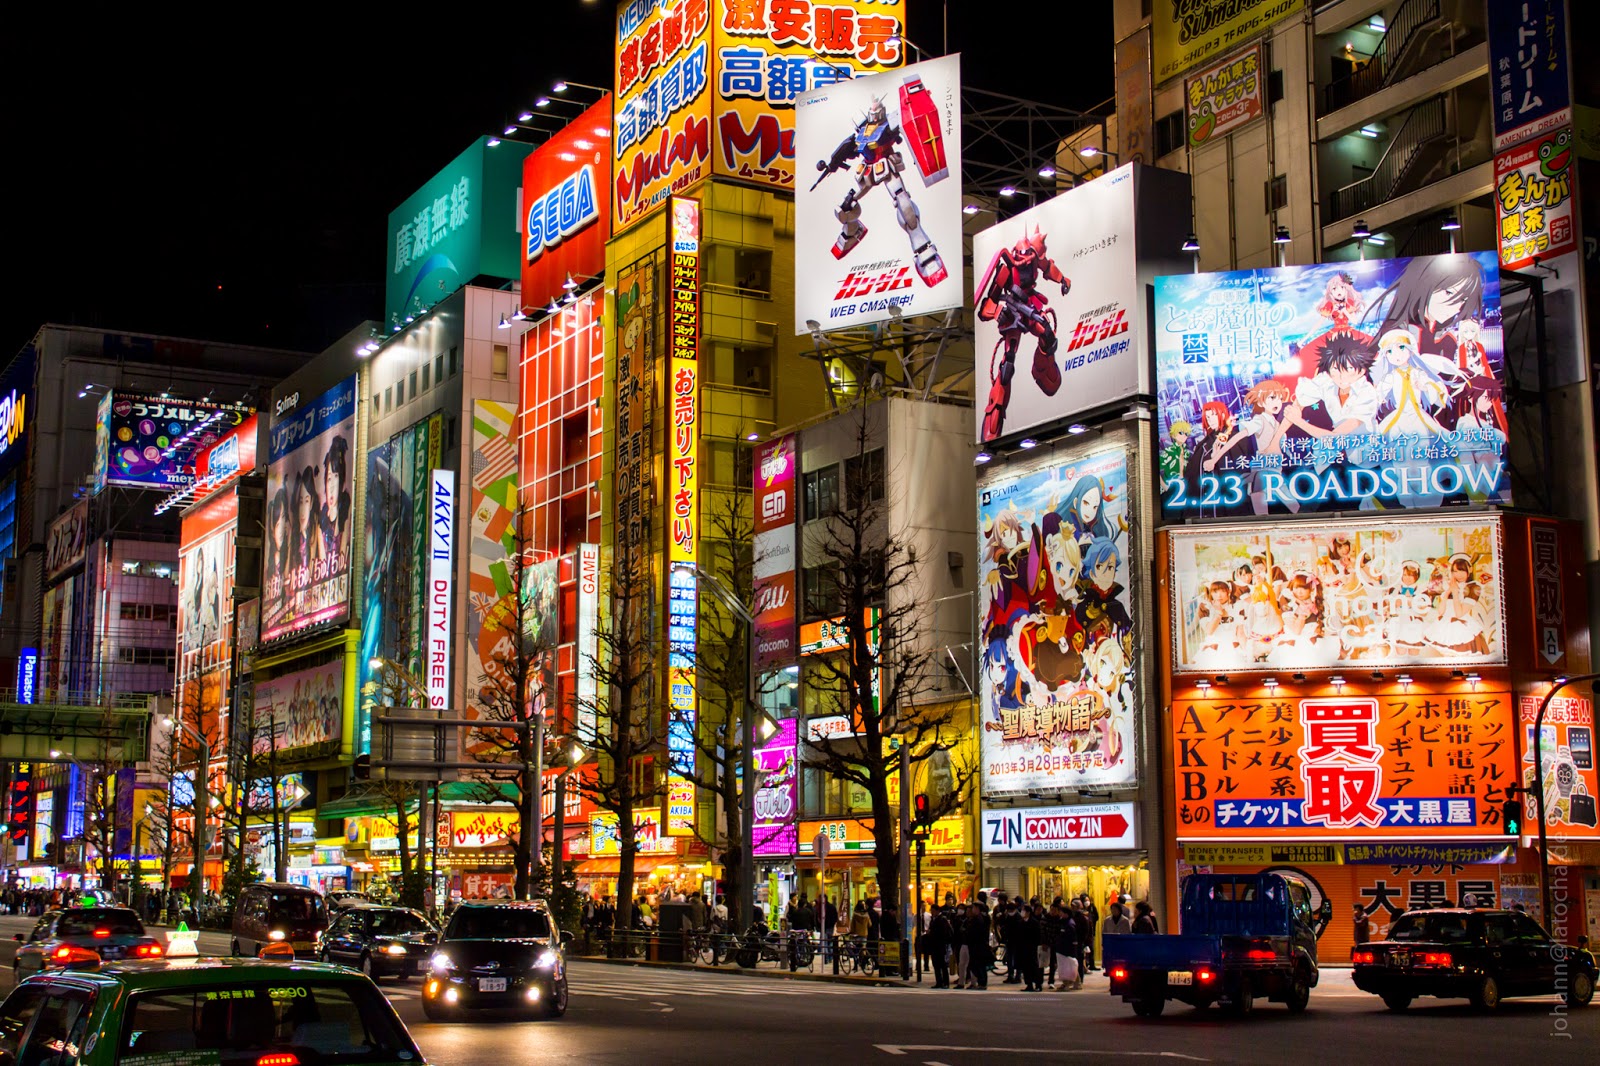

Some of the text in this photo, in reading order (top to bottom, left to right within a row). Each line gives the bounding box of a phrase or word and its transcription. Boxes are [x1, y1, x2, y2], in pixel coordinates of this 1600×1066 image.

[722, 0, 901, 64] 激安販売
[720, 46, 880, 104] 高額買
[1189, 54, 1258, 108] まんが喫茶
[1499, 56, 1514, 123] 秋葉原店
[1500, 114, 1567, 147] AMENITY DREAM
[616, 116, 709, 222] Mulan
[651, 185, 671, 206] AKIBA
[1499, 170, 1570, 212] まんが
[528, 164, 599, 260] SEGA
[1501, 207, 1546, 241] 喫茶
[1502, 233, 1549, 264] ゲラゲラ
[1552, 227, 1570, 243] 3F
[675, 255, 696, 267] DVD
[677, 290, 693, 300] CD
[834, 266, 913, 300] ガンダム
[674, 313, 696, 324] アニメ
[830, 304, 856, 318] WEB
[1067, 308, 1129, 353] ガンダム
[1065, 354, 1086, 372] WEB
[276, 391, 299, 416] Sofmap
[1166, 462, 1505, 507] 2.23 ROADSHOW
[434, 480, 451, 547] AKKY
[765, 543, 791, 558] SoftBank
[583, 550, 595, 594] GAME
[433, 580, 448, 632] DUTY
[759, 585, 789, 611] au
[758, 637, 790, 653] docomo
[431, 639, 446, 689] FREE
[1212, 704, 1240, 794] アイドル
[1240, 704, 1266, 770] アニメ
[1266, 702, 1296, 796] 美少女系
[1387, 702, 1415, 796] フィギュア
[1415, 701, 1441, 768] ホビー
[1445, 699, 1476, 795] 携帯電話
[1300, 699, 1386, 828] 買取
[670, 806, 692, 815] AKIBA
[1026, 816, 1102, 839] COMIC ZIN
[1047, 807, 1063, 816] Support
[1070, 806, 1090, 815] Magazine
[1217, 802, 1299, 825] チケット
[1389, 800, 1472, 824] 大黒屋
[987, 811, 1022, 849] ZIN
[1026, 841, 1068, 850] Akihabara
[1188, 847, 1264, 855] MONEY TRANSFER
[1272, 846, 1325, 854] WESTERN
[1288, 854, 1325, 862] UNION
